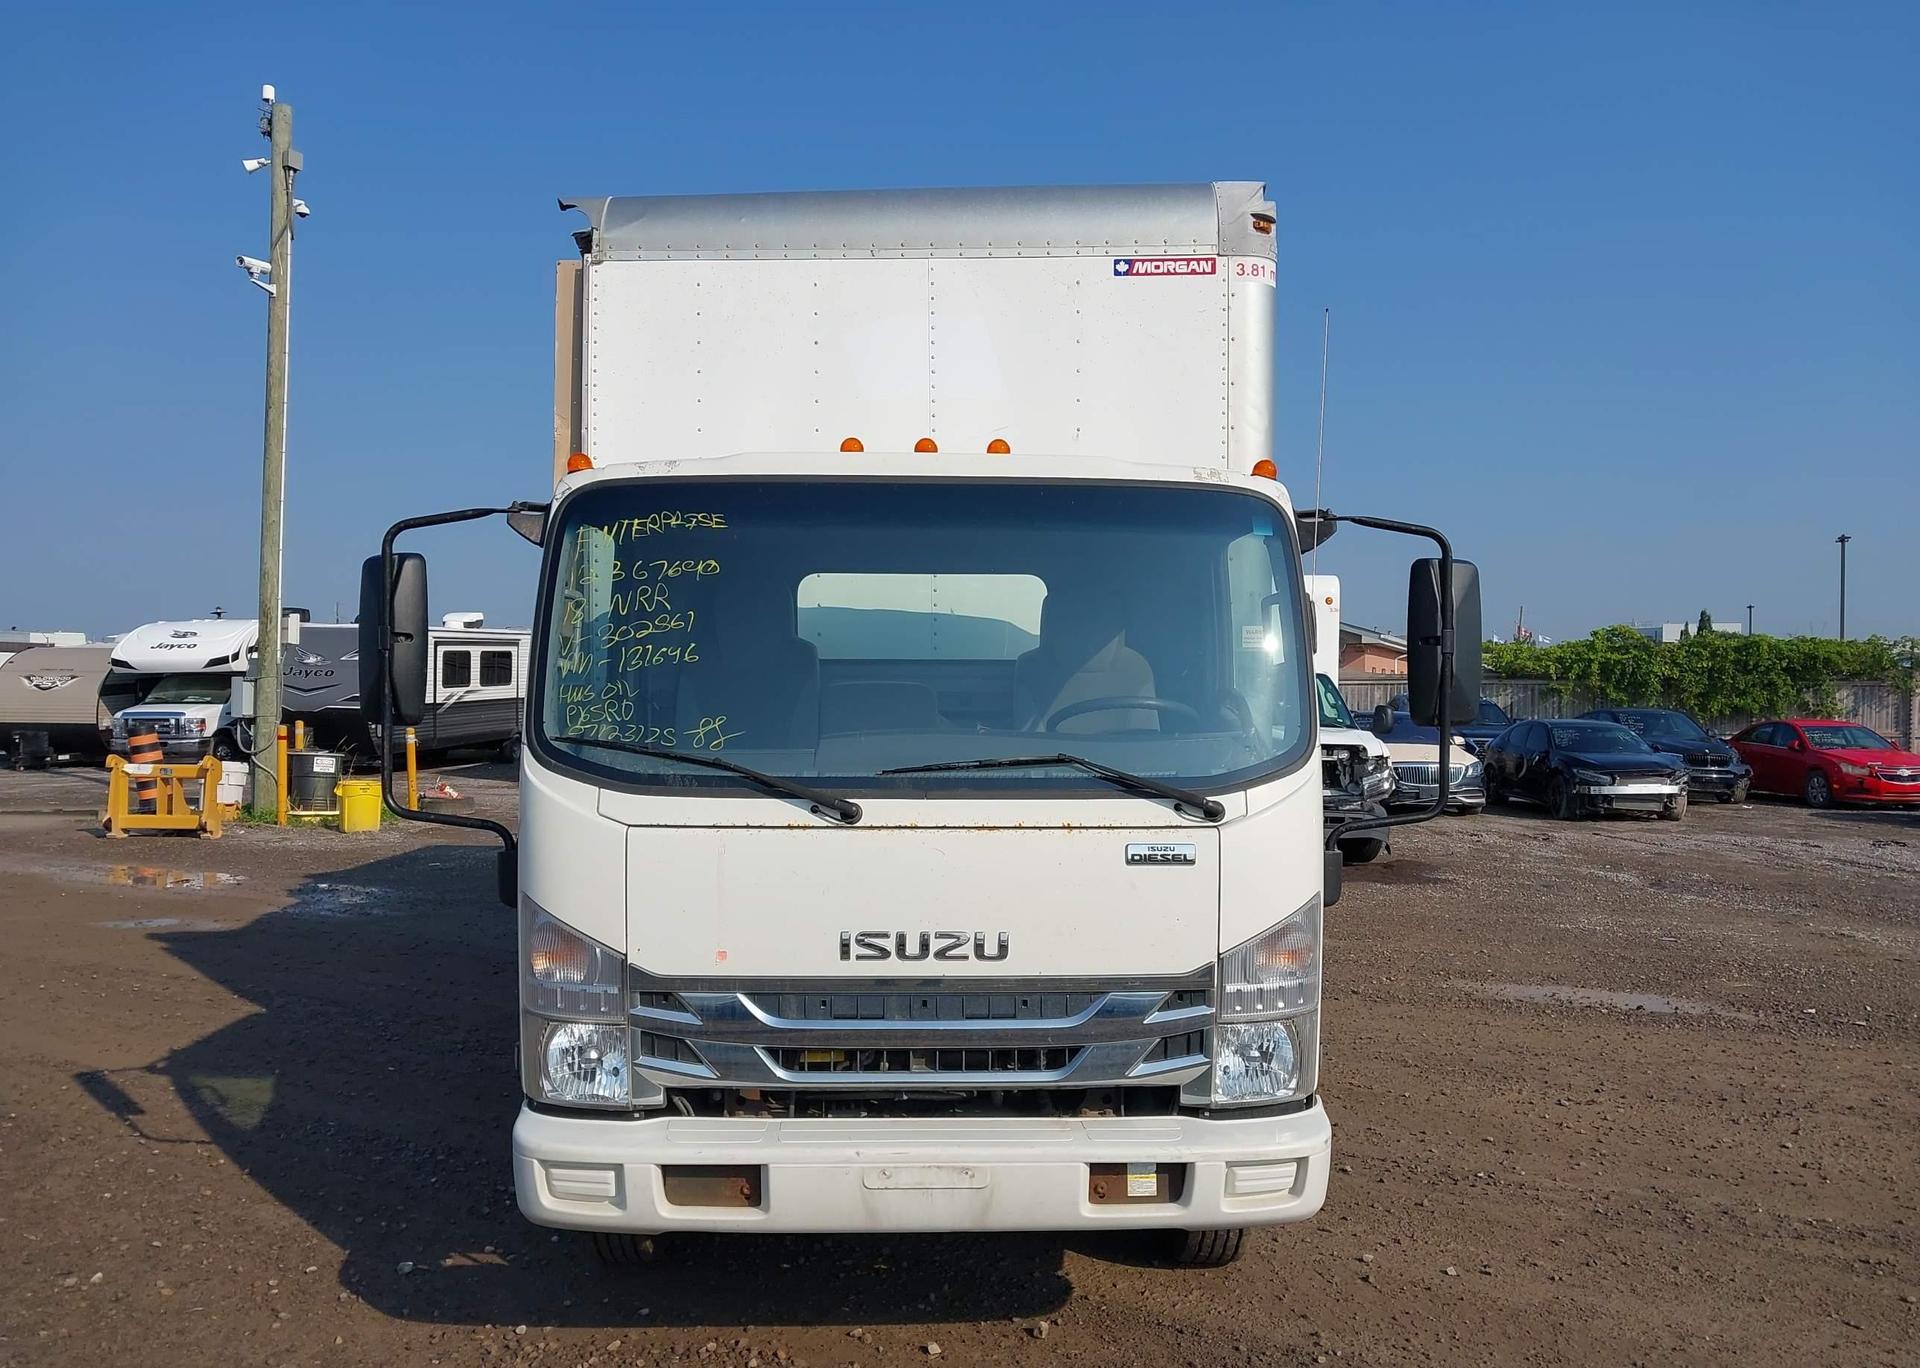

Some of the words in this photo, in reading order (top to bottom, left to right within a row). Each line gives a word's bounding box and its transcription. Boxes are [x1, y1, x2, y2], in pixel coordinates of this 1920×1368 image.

[1132, 260, 1214, 274] MORGAN
[1236, 262, 1266, 278] 3.81
[150, 642, 198, 650] Jayco
[282, 666, 335, 679] Jayco
[1130, 854, 1195, 863] DIESEL
[839, 931, 1010, 962] ISUZU
